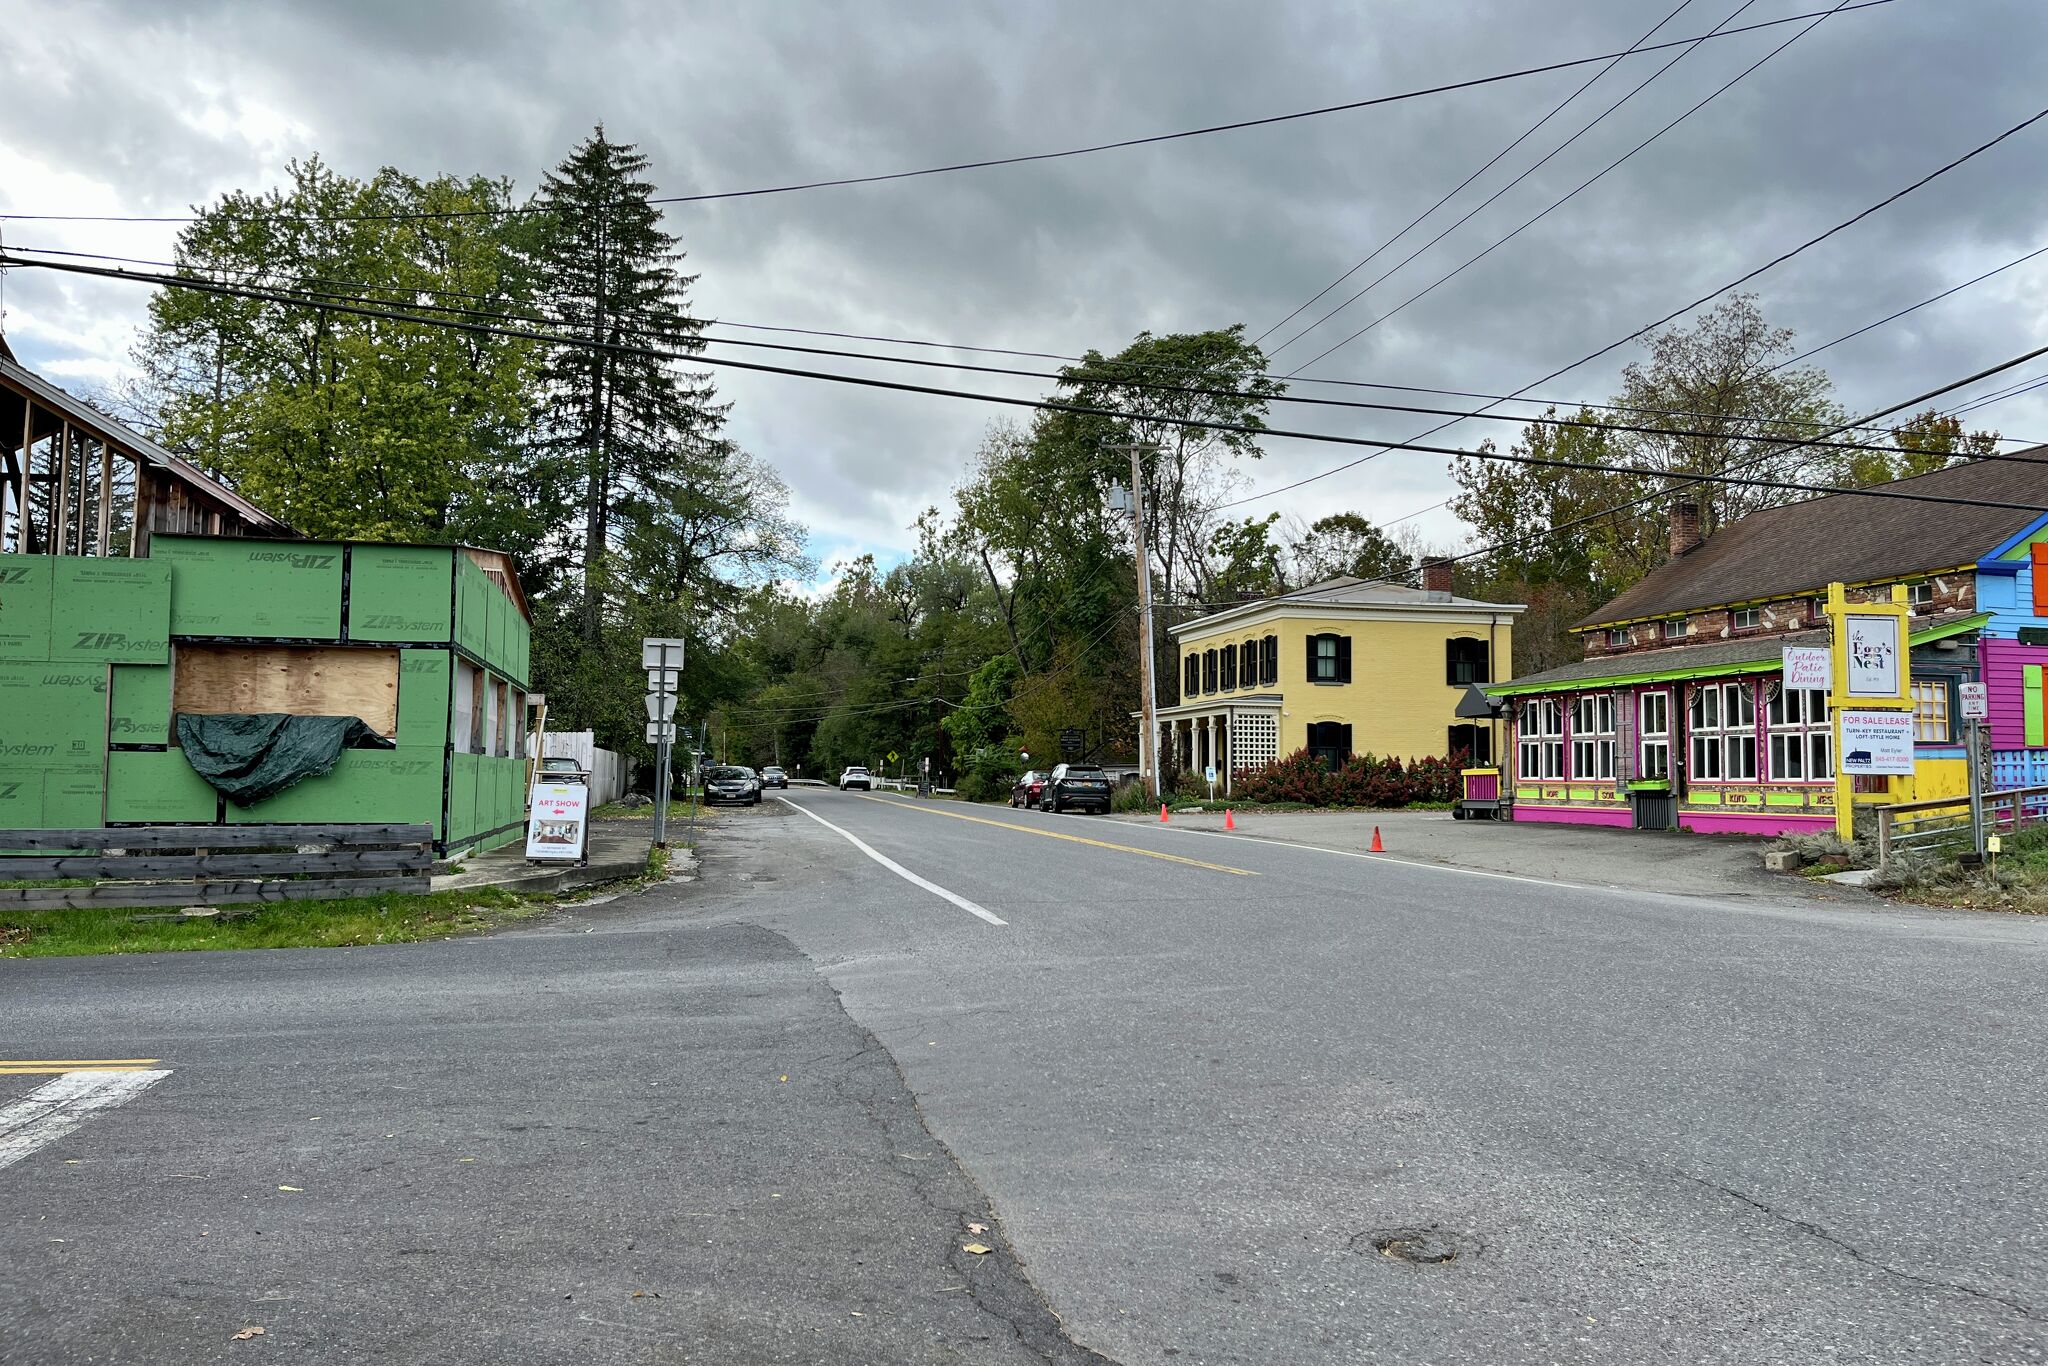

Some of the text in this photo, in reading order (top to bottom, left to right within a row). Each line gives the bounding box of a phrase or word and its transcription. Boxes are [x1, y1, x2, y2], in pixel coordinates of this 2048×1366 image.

[1788, 651, 1825, 661] Outdoor
[1853, 642, 1892, 659] Egg's
[1793, 661, 1823, 671] Patio
[1853, 656, 1884, 669] Nest
[1791, 671, 1824, 687] Dining
[1843, 716, 1860, 724] FOR
